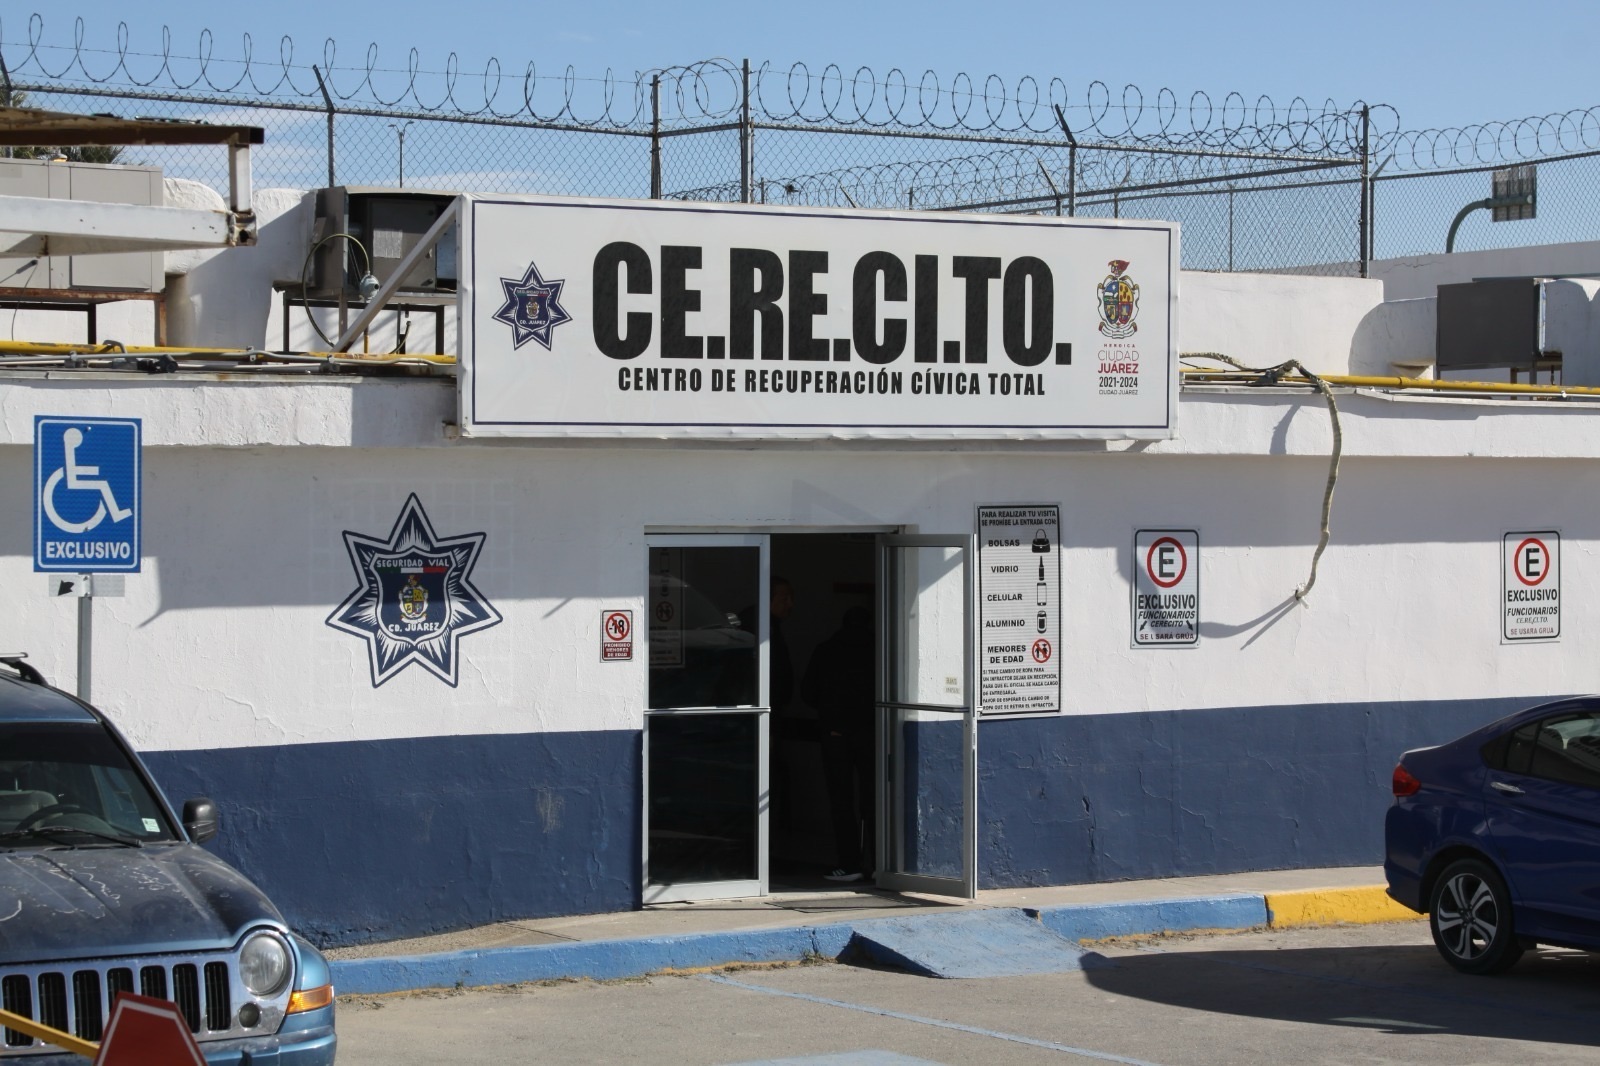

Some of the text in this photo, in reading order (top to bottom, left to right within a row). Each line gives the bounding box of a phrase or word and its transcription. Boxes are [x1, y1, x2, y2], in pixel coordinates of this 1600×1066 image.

[592, 241, 1072, 366] CE.RE.CI.TO.
[1098, 350, 1140, 362] CIUDAD
[1098, 360, 1139, 374] JUÁREZ
[618, 366, 1045, 395] CENTRO DE RECUPERACIÓN CÍVICA TOTAL
[1099, 376, 1138, 388] 2021-2024
[46, 542, 130, 559] EXCLUSIVO
[376, 558, 450, 568] SEGURIDAD VIAL
[1159, 547, 1175, 578] E
[1526, 548, 1540, 577] E
[987, 593, 1023, 601] CELULAR
[1138, 594, 1196, 609] EXCLUSIVO
[1507, 589, 1558, 602] EXCLUSIVO
[1138, 610, 1196, 619] FUNCIONARIOS
[1507, 606, 1558, 616] FUNCIONARIOS
[388, 624, 402, 633] CD.
[986, 619, 1025, 628] ALUMINIO
[987, 645, 1026, 653] MENORES
